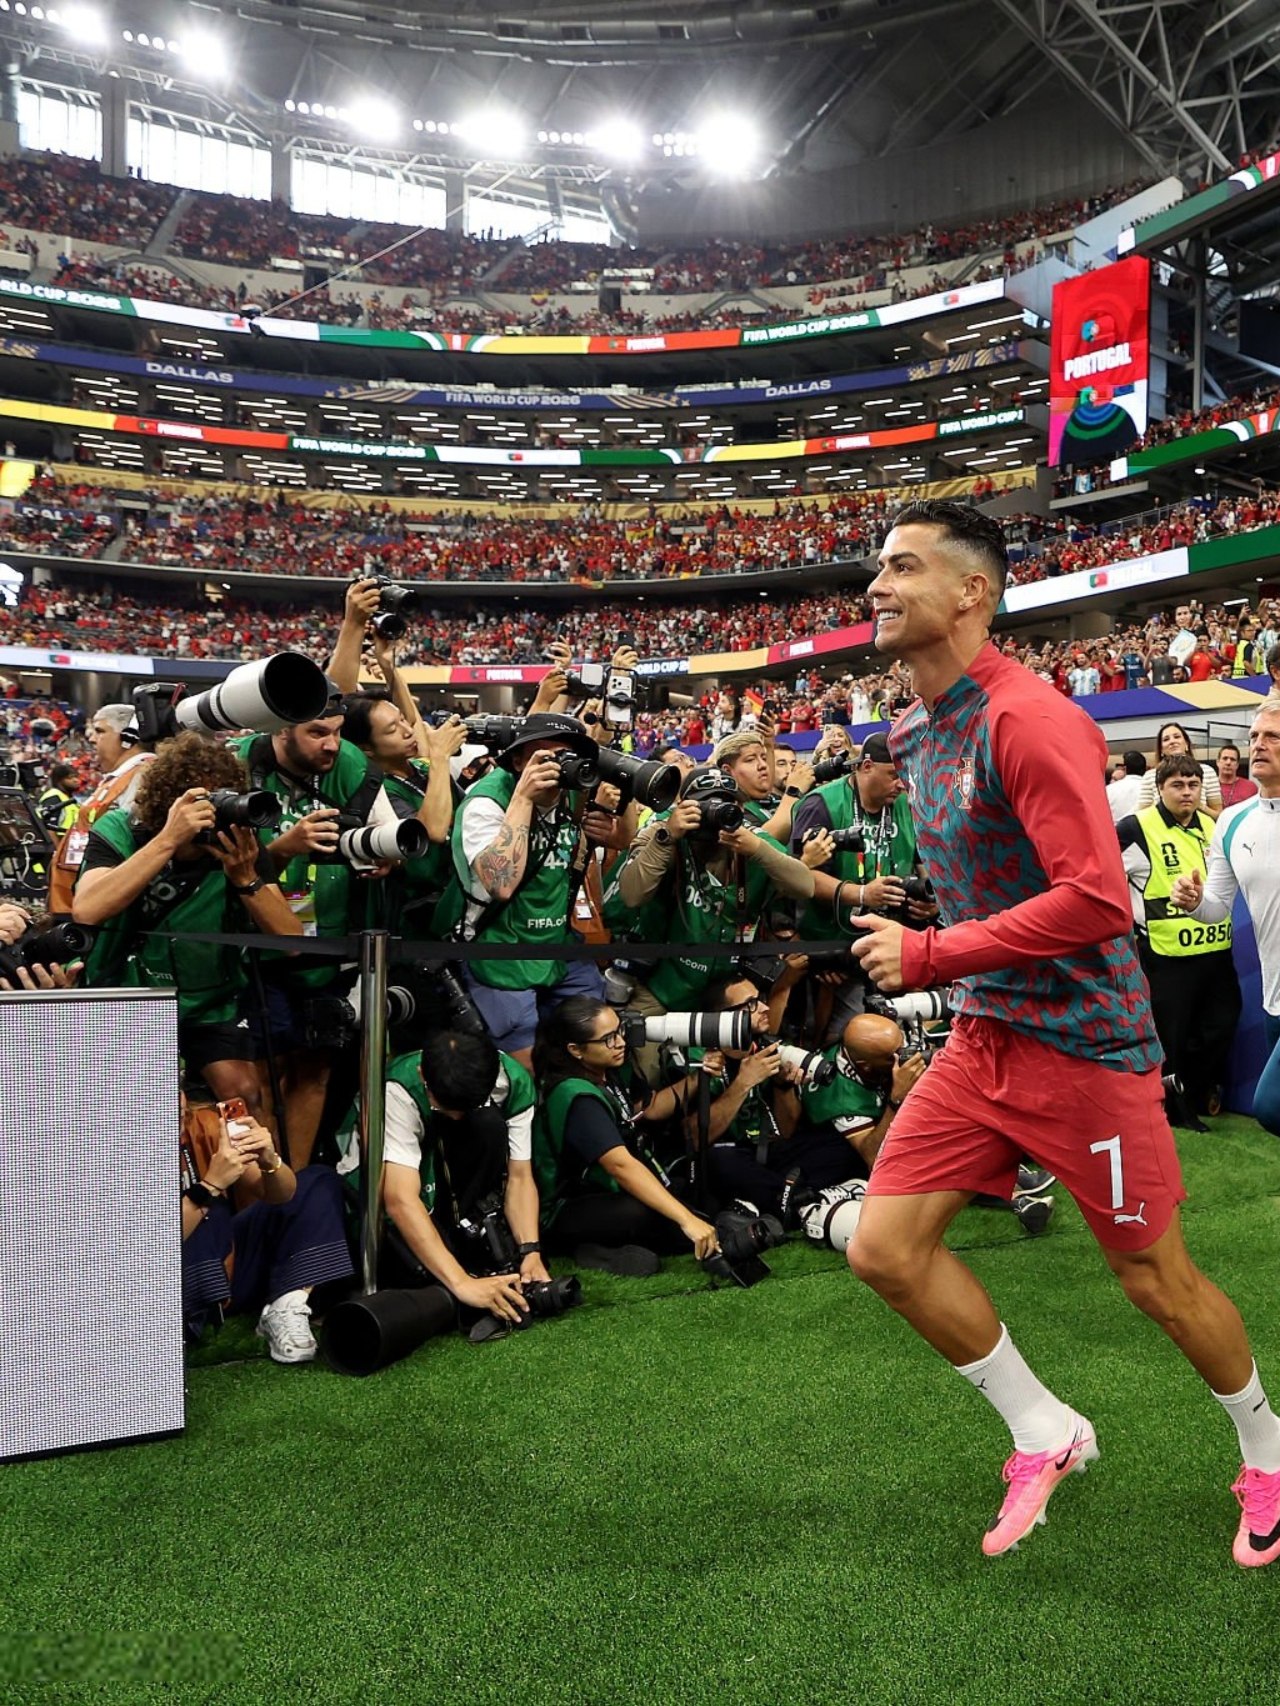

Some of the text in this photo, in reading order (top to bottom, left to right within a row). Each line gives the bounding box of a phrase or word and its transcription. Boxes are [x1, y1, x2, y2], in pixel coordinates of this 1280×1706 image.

[33, 284, 67, 300] CUP
[743, 328, 768, 343] FIFA
[768, 322, 807, 339] WORLD
[807, 317, 829, 331] CUP
[1064, 342, 1132, 381] PORTUGAL
[146, 362, 234, 383] DALLAS
[765, 379, 832, 397] DALLAS
[445, 392, 581, 406] FIFA WORLD CUP 2026
[940, 422, 962, 435] FIFA
[961, 416, 997, 432] WORLD
[997, 411, 1018, 425] CUP
[292, 437, 320, 450] FIFA
[320, 439, 362, 455] WORLD
[363, 444, 386, 457] CUP
[1089, 1135, 1124, 1210] 7
